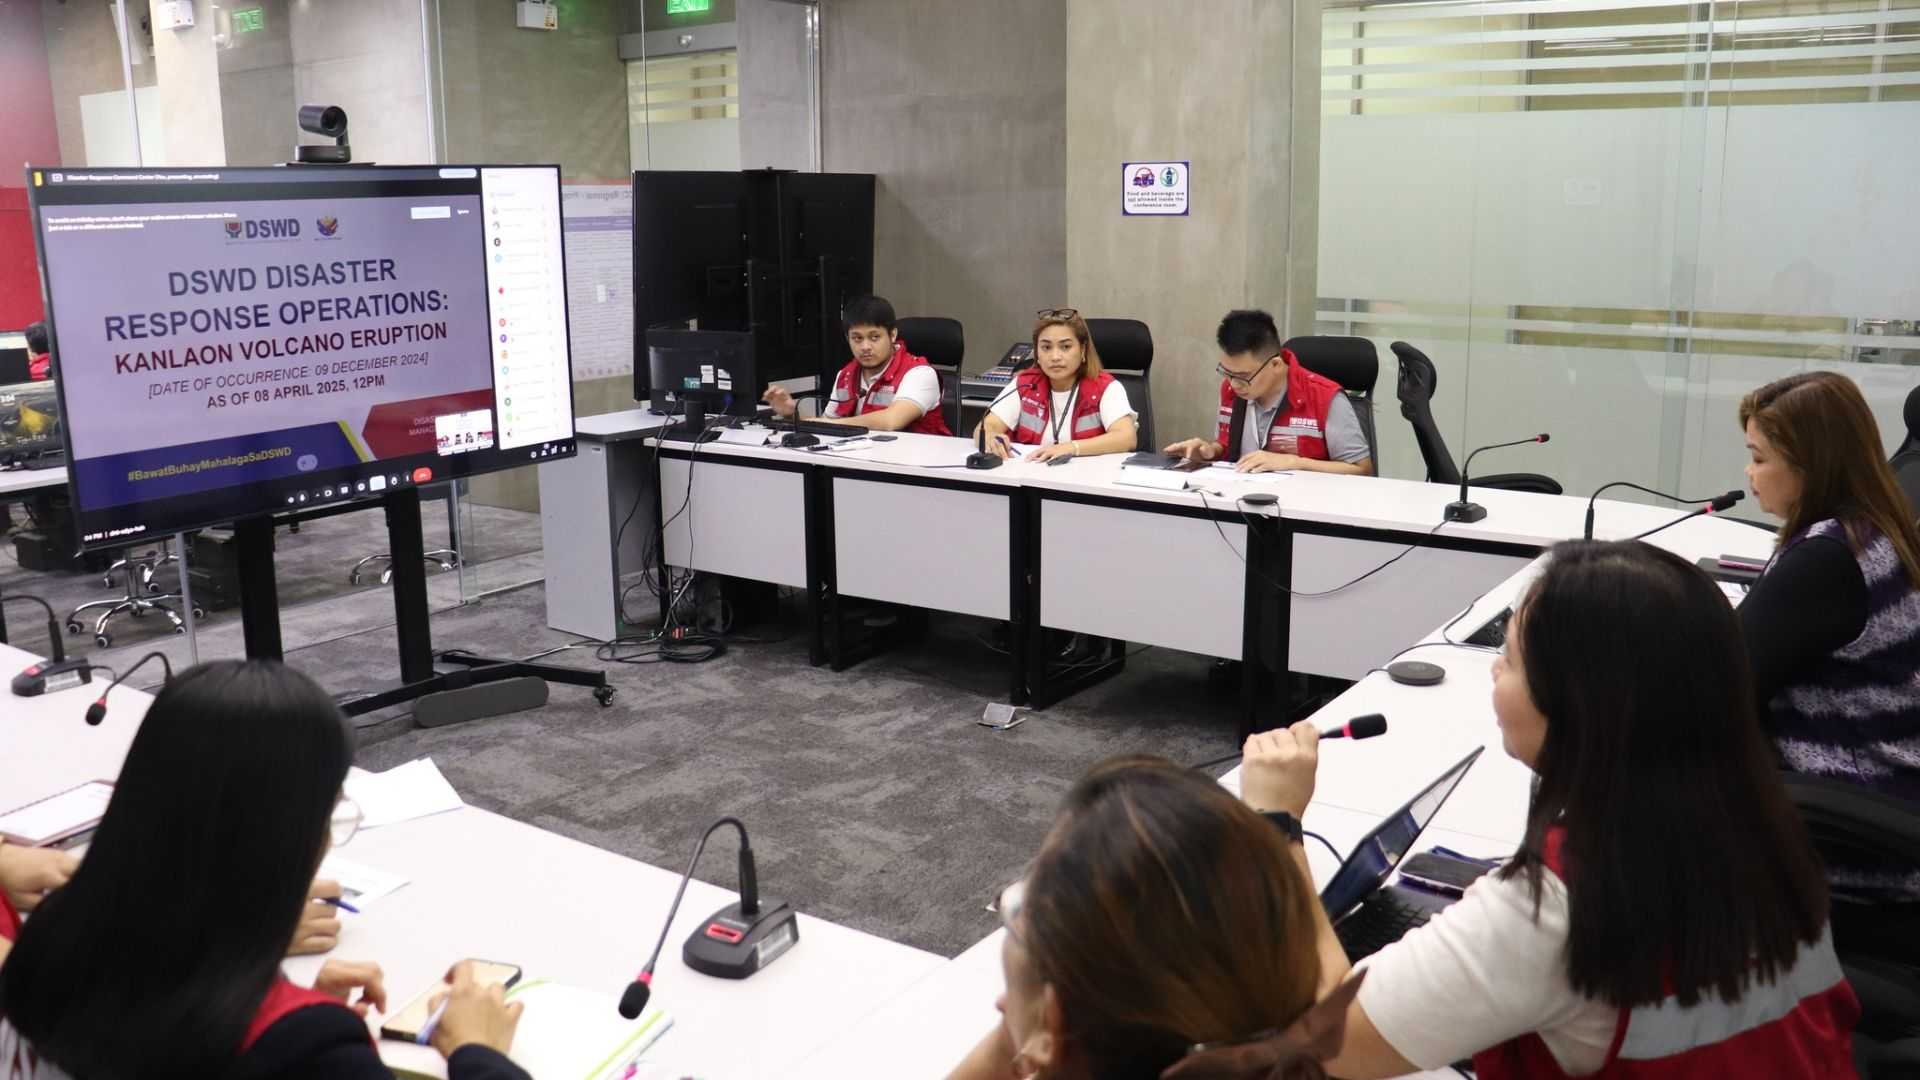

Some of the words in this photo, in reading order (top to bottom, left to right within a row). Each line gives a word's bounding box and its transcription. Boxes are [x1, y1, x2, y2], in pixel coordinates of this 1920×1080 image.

[245, 218, 301, 239] DSWD
[168, 267, 257, 297] DSWD
[266, 258, 397, 290] DISASTER
[104, 303, 271, 342] RESPONSE
[279, 289, 448, 326] OPERATIONS:
[115, 343, 233, 375] KANLAON
[240, 332, 344, 361] VOLCANO
[351, 321, 447, 349] ERUPTION
[148, 380, 190, 400] [DATE
[193, 377, 212, 392] OF
[216, 366, 310, 389] OCCURRENCE:
[315, 363, 329, 377] 09
[332, 355, 399, 375] DECEMBER
[401, 351, 429, 367] 2024]
[207, 394, 227, 409] AS
[231, 391, 251, 405] OF
[254, 388, 270, 402] 08
[273, 384, 313, 401] APRIL
[317, 379, 350, 395] 2025,
[353, 374, 385, 390] 12PM
[128, 446, 292, 482] #BawatBuhayMahalagaSaDSWD
